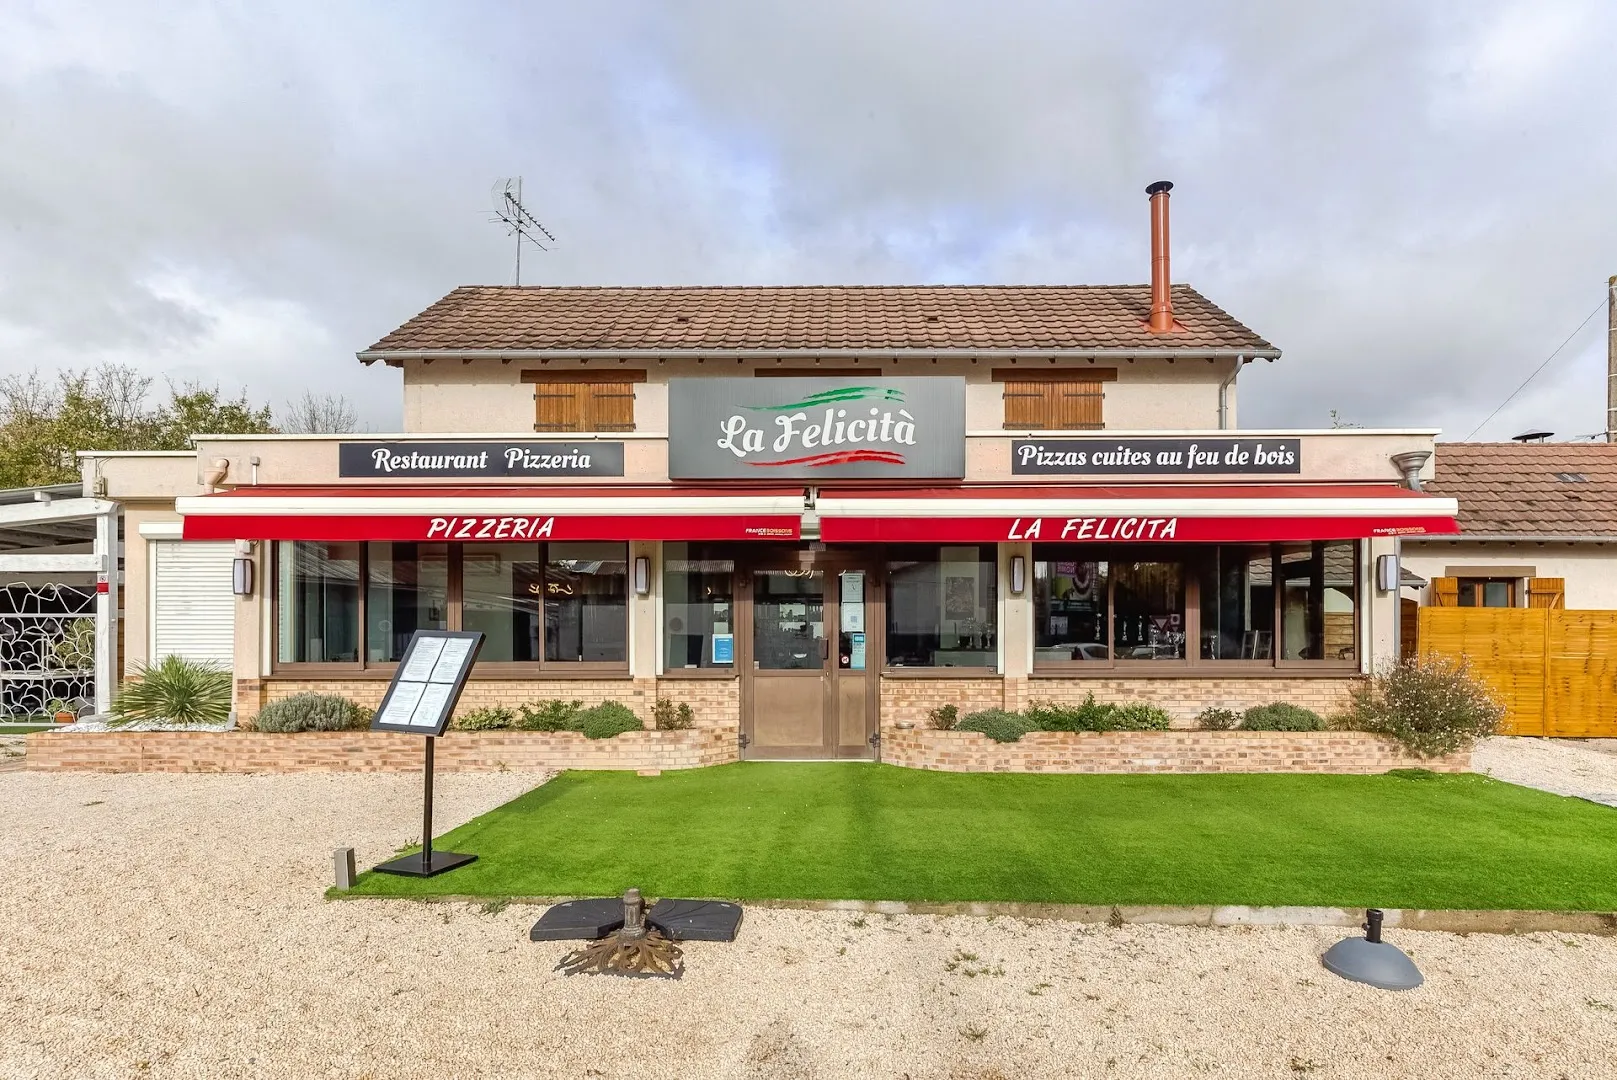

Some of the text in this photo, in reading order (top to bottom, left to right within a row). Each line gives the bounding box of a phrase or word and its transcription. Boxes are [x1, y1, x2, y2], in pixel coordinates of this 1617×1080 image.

[717, 408, 917, 458] La Felicità
[371, 447, 591, 472] Restaurant Pizzeria
[1017, 444, 1295, 470] Pizzas cuites au feu de bois
[426, 517, 554, 539] PIZZERIA
[1007, 518, 1178, 540] LA FELICITA
